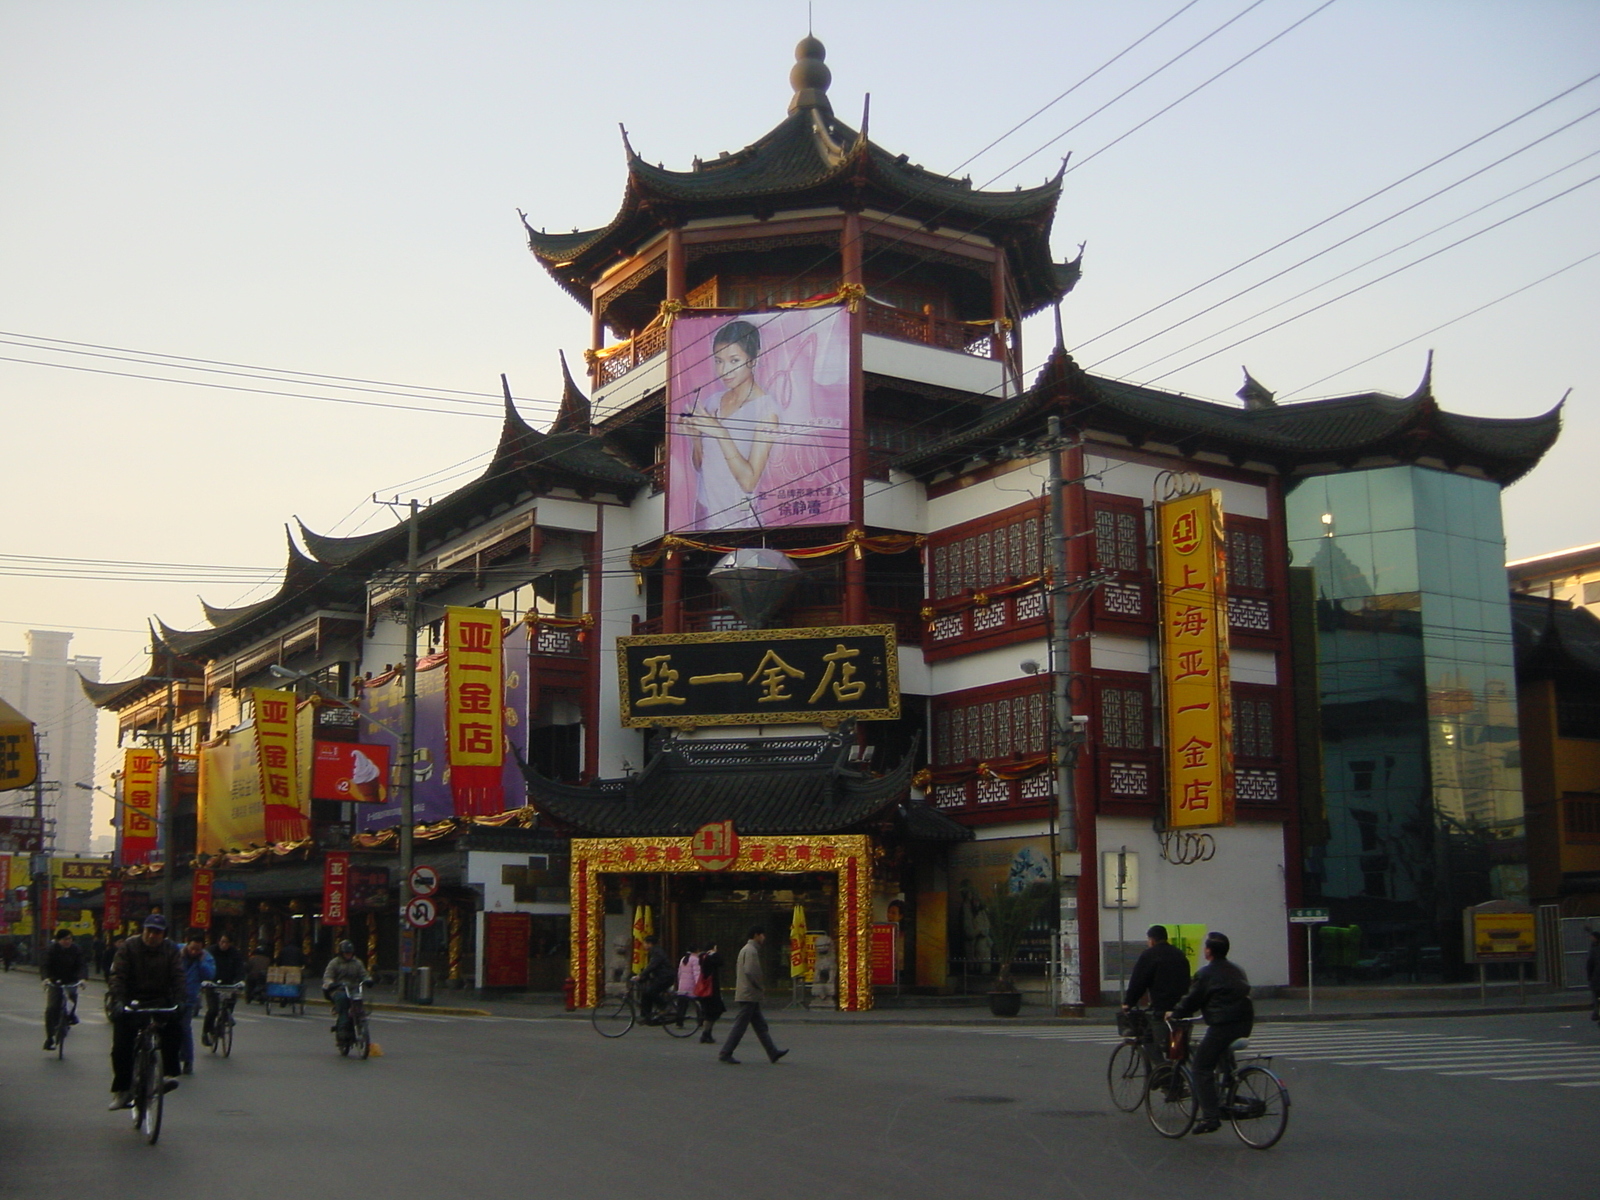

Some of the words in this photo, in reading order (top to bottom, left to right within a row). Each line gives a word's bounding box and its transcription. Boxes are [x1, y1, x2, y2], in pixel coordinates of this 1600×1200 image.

[458, 621, 494, 755] 亚一金店
[635, 644, 867, 707] 亞一金店
[1172, 564, 1213, 811] 上海亚一金店
[261, 700, 290, 798] 亚一金店
[130, 755, 154, 832] 亚一金店
[327, 862, 344, 918] 亚一金店
